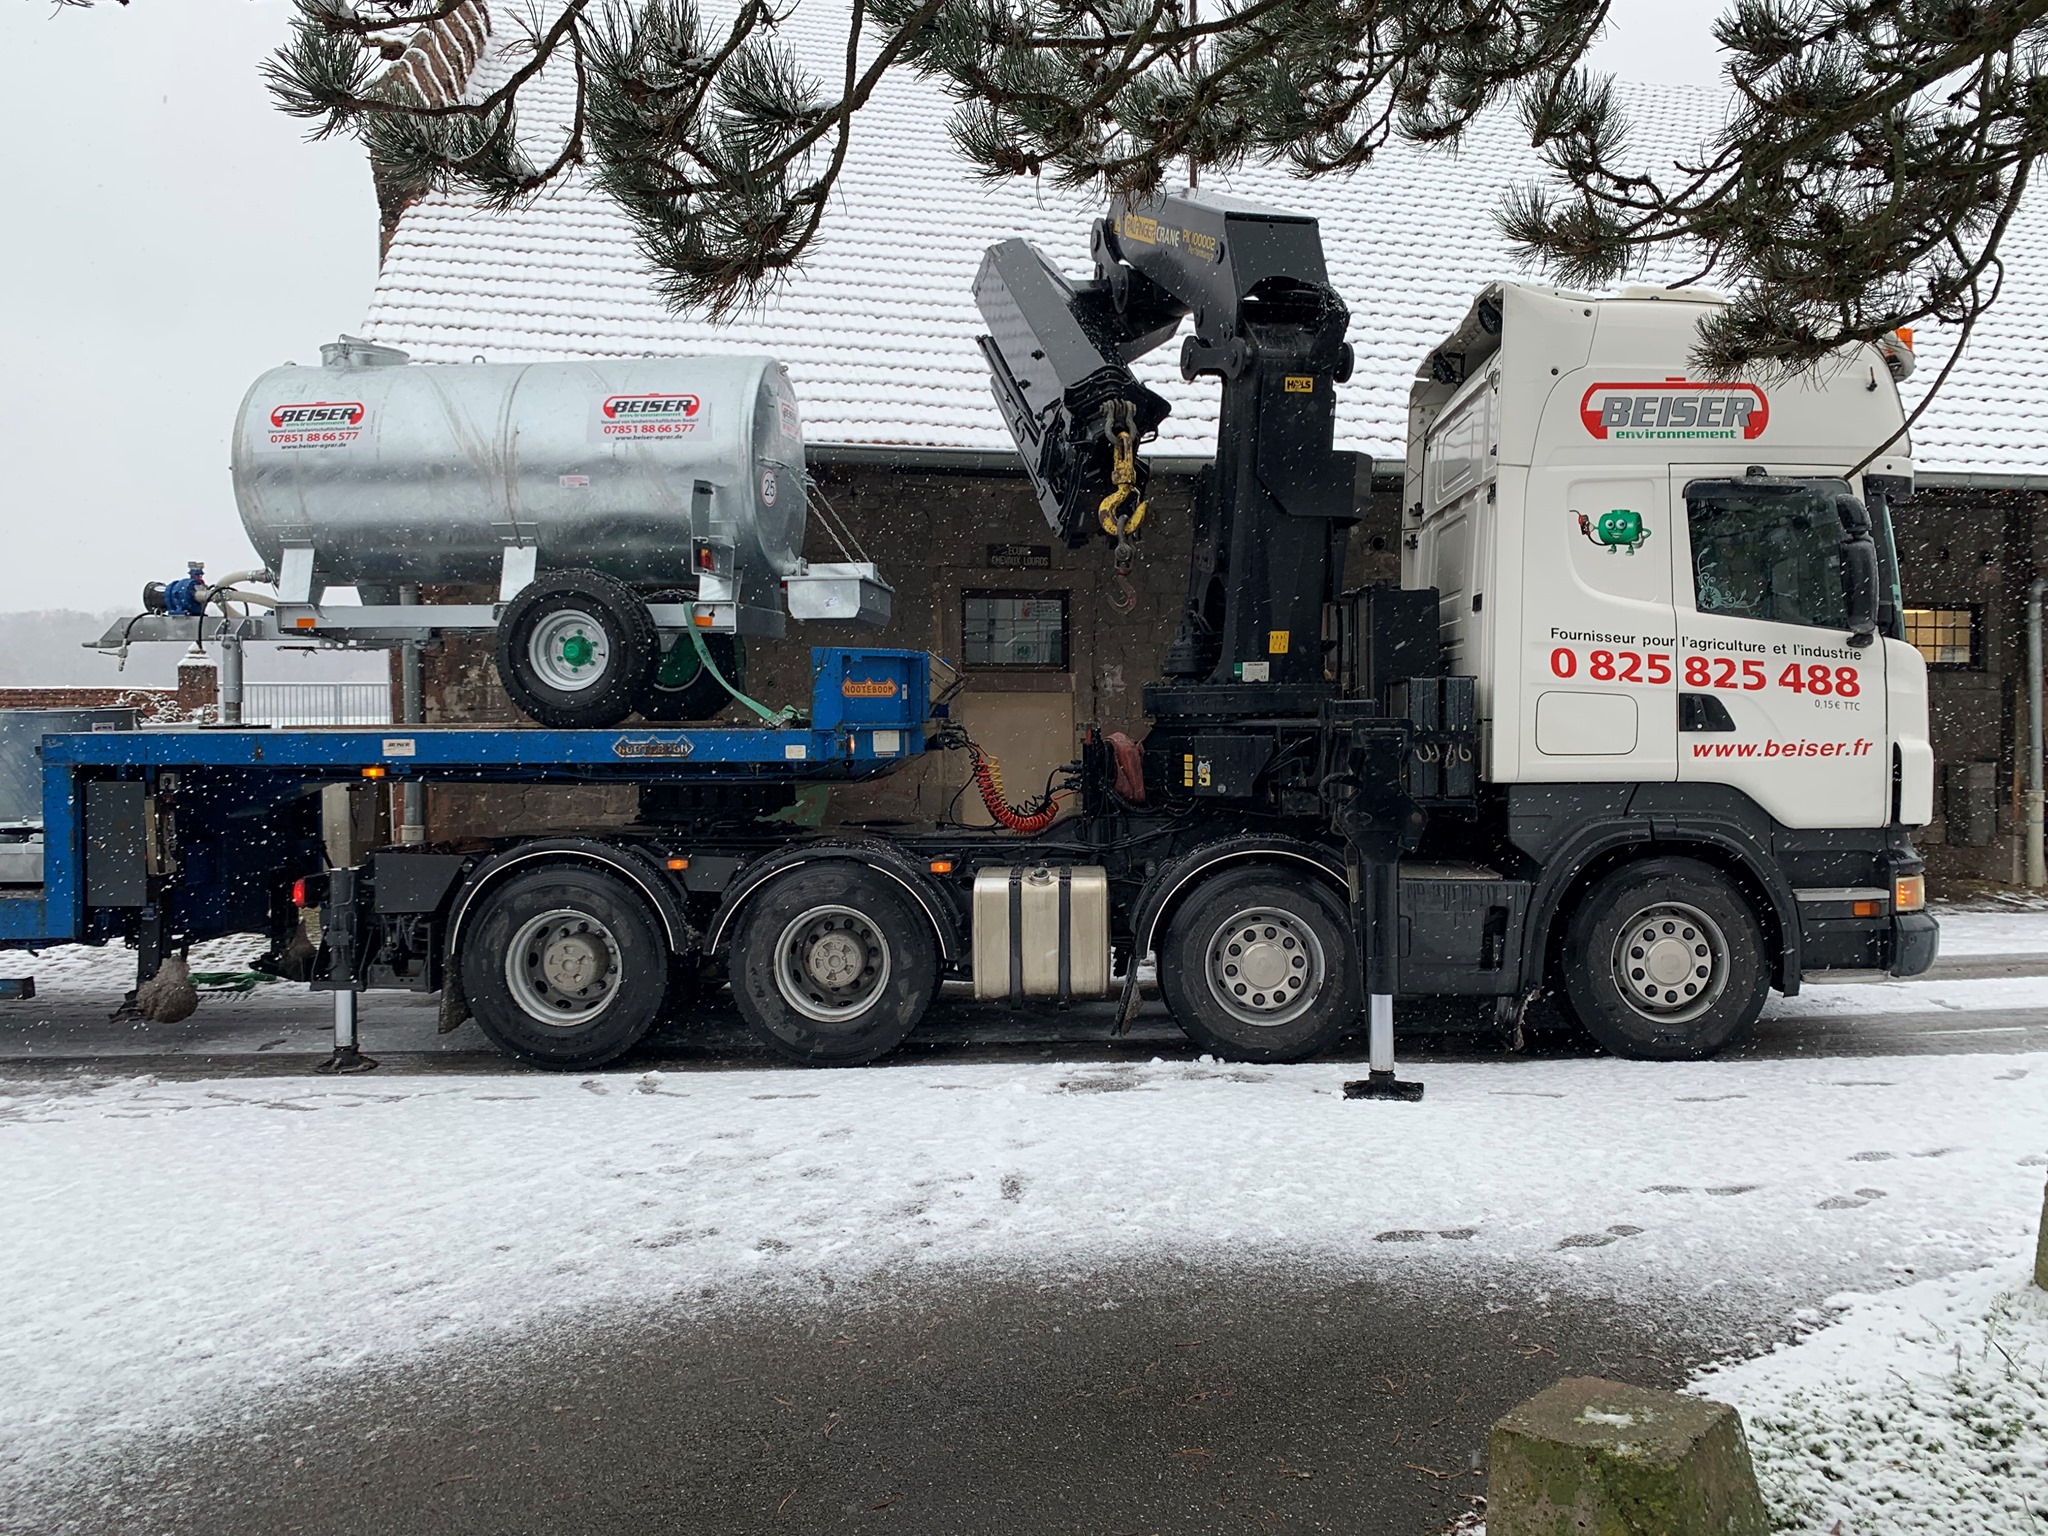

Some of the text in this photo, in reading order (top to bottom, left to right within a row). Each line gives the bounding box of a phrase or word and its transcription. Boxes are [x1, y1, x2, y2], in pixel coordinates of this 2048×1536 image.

[1156, 225, 1180, 247] CRANE
[1182, 229, 1216, 251] PK 100002
[612, 400, 693, 413] BEISER
[1600, 396, 1755, 428] BEISER
[279, 408, 358, 422] BEISER
[604, 423, 695, 434] 07851 88 66 577
[1616, 428, 1737, 439] environnement
[270, 431, 359, 443] 07851 88 66 577
[764, 479, 775, 497] 25
[1550, 627, 1862, 660] Fournisseur pour l'agriculture et l'industrie
[1550, 647, 1861, 697] 0 825 825 488
[844, 684, 894, 693] NOOTEBOOM
[1844, 701, 1861, 711] TTC
[1693, 738, 1873, 757] www.beiser.fr
